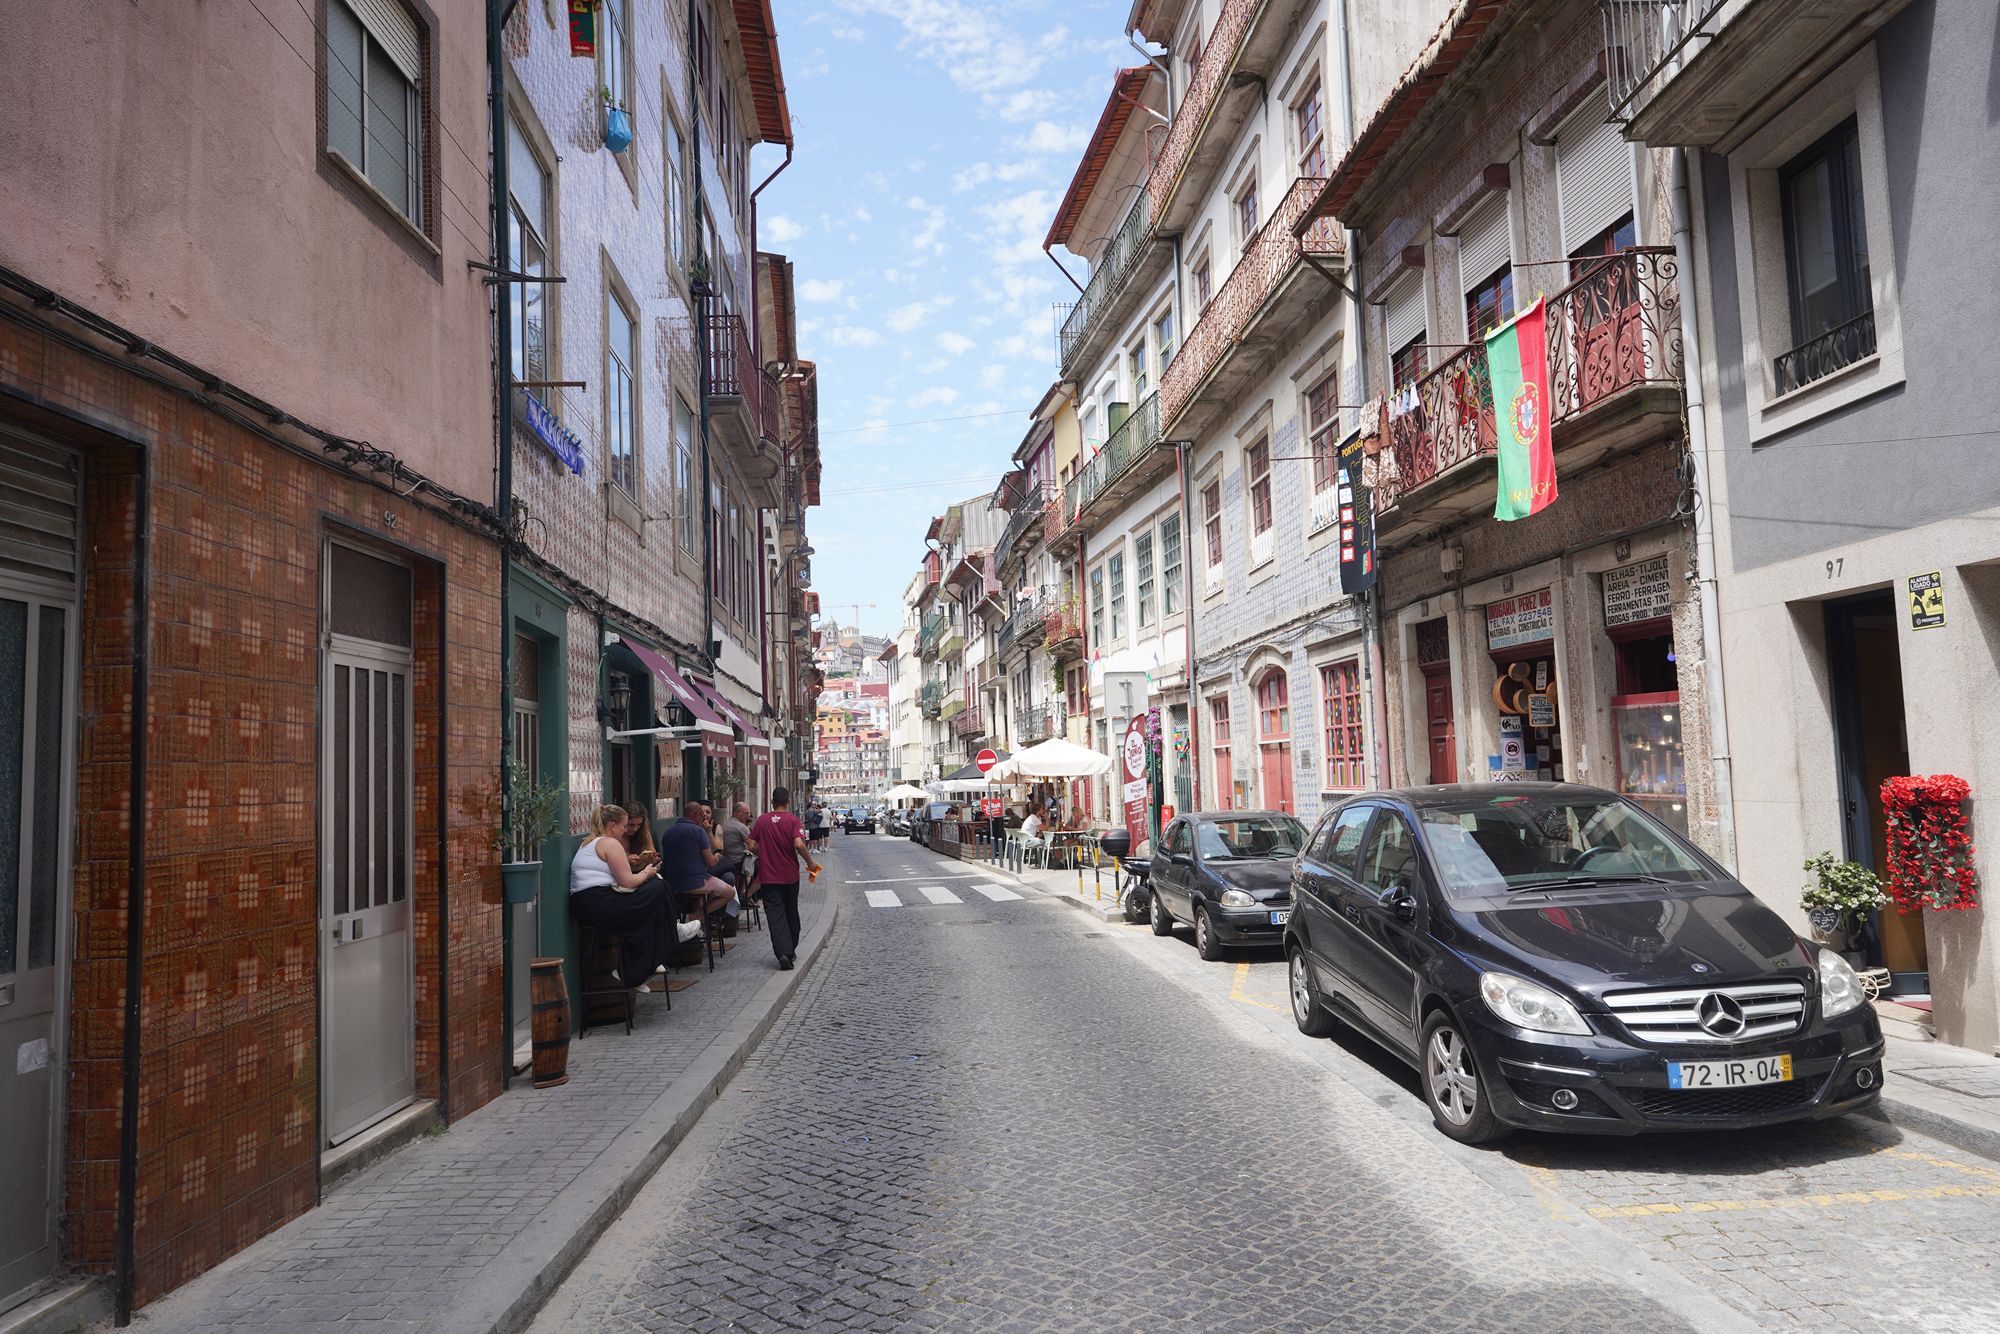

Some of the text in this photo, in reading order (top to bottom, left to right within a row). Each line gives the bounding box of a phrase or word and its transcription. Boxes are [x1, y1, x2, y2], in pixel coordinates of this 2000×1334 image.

[384, 510, 397, 529] 92
[1606, 566, 1636, 582] TELHAS
[1826, 557, 1844, 579] 97
[1607, 579, 1630, 593] AREIA
[1910, 575, 1930, 584] ALARME
[1911, 580, 1931, 590] LIGADO
[1518, 593, 1538, 612] PEREZ
[1607, 596, 1652, 615] FERRAMENTAS
[1489, 619, 1501, 629] TEL
[1502, 615, 1516, 625] FAX
